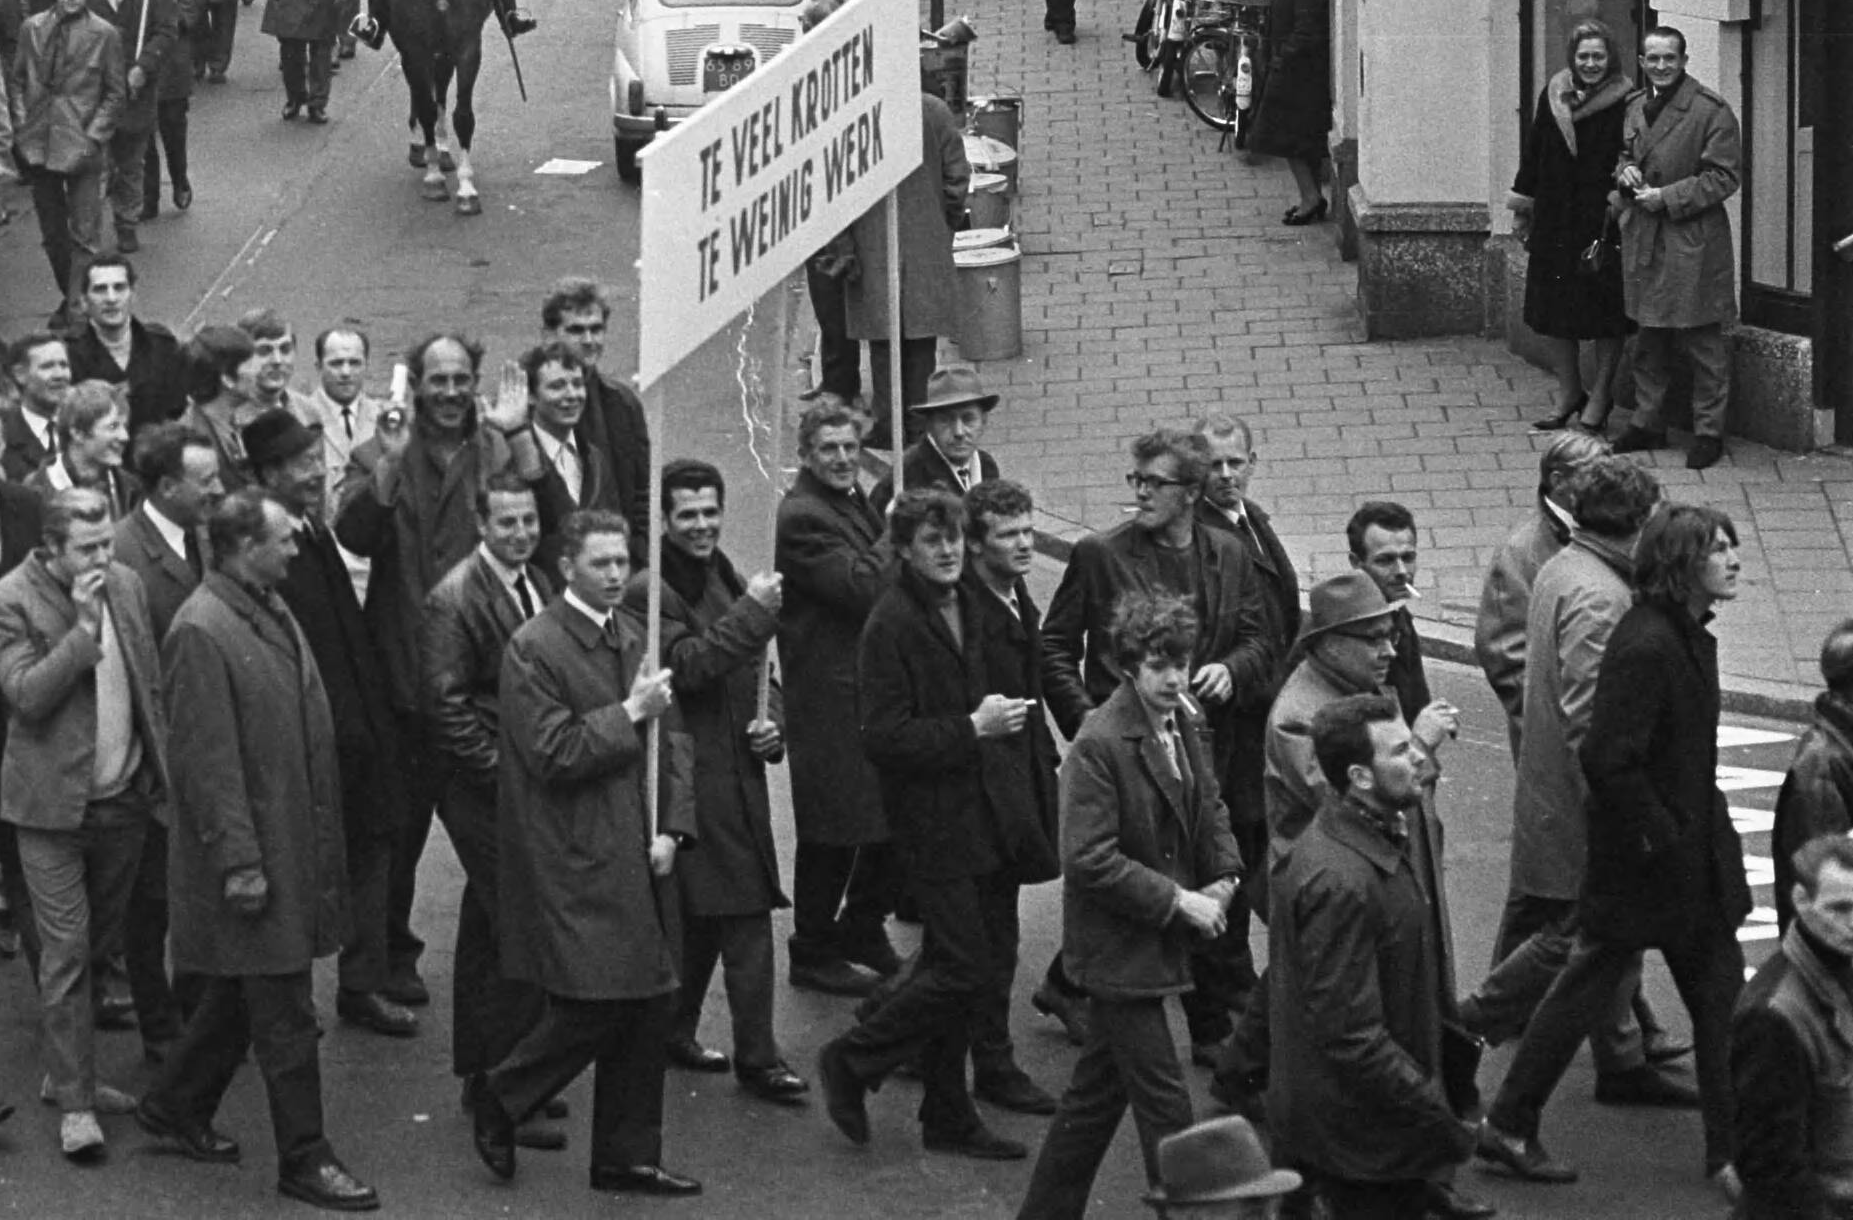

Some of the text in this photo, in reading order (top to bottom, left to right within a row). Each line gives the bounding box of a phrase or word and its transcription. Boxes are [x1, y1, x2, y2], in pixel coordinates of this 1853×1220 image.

[698, 101, 885, 303] TE WEINIG WERK
[699, 24, 875, 212] TE VEEL KROTTEN
